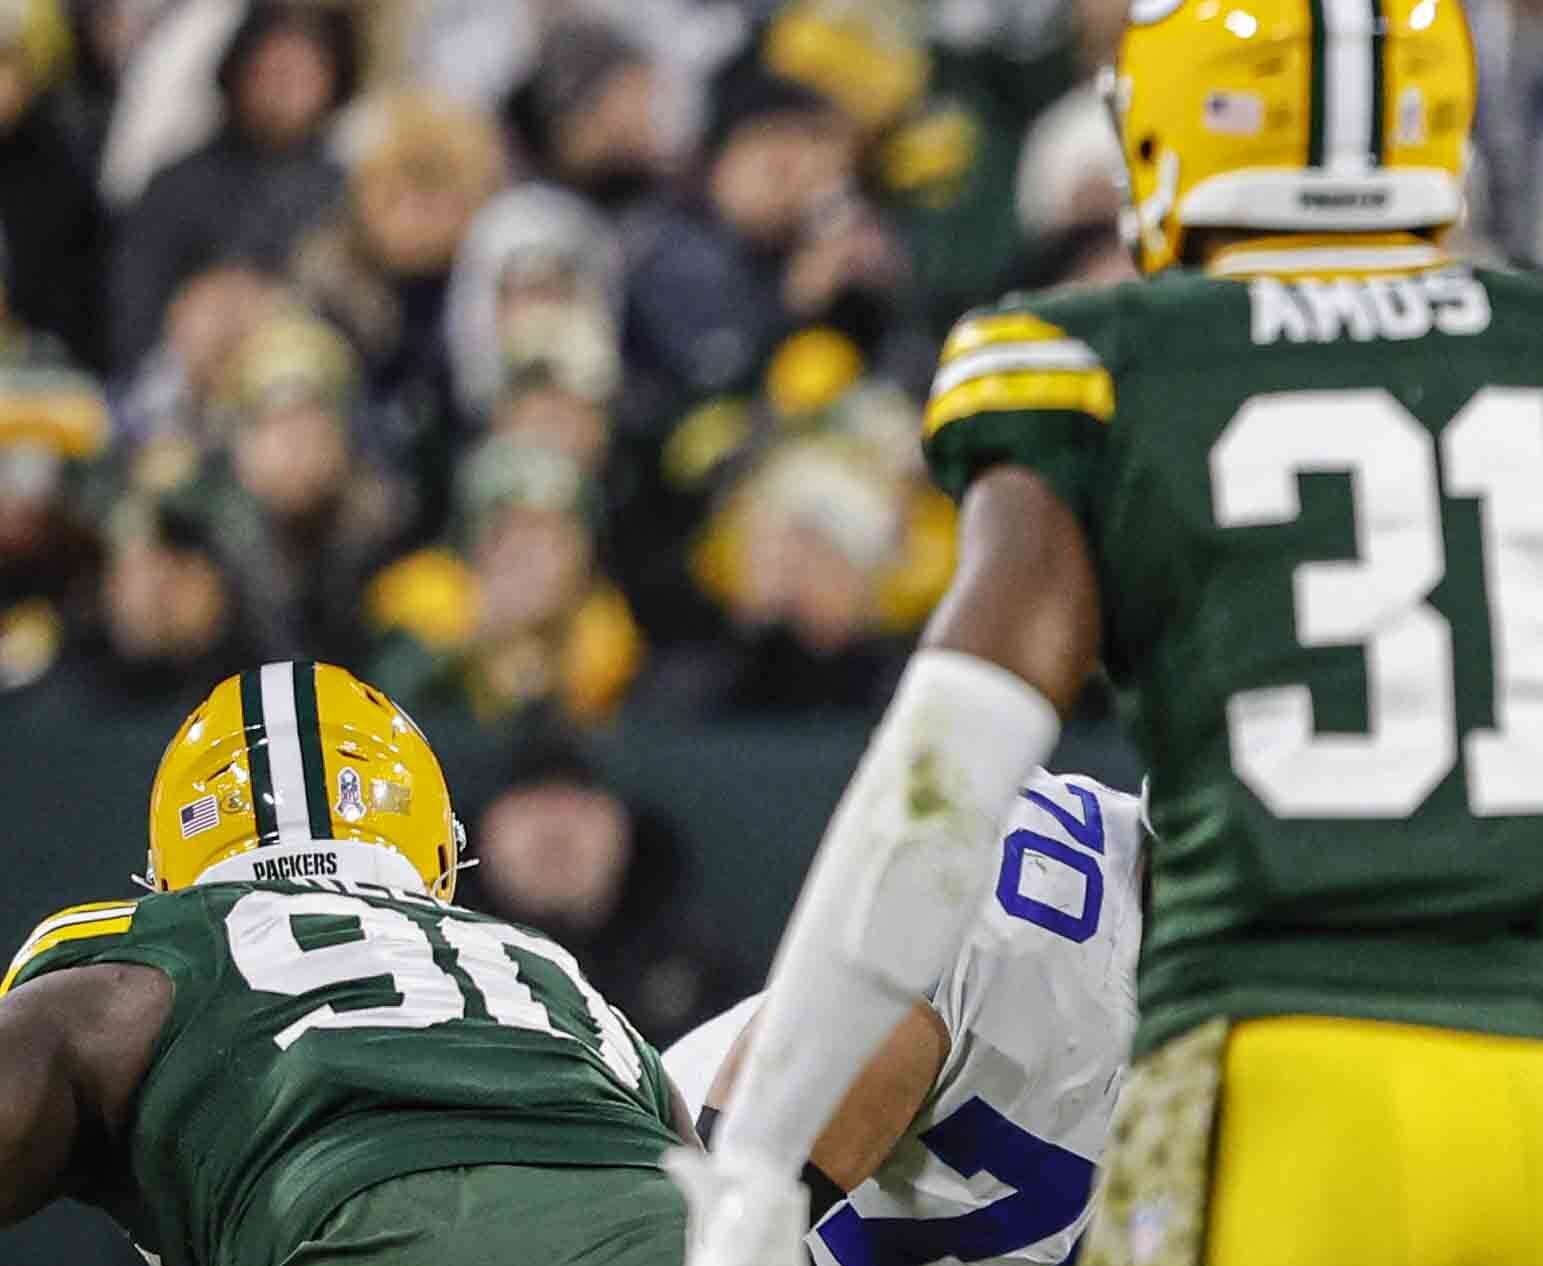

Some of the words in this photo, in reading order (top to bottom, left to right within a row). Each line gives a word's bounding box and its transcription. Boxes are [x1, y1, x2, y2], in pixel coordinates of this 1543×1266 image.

[1249, 276, 1492, 344] AMOS
[253, 852, 337, 881] PACKERS
[996, 783, 1104, 943] 70
[224, 889, 642, 1088] 90
